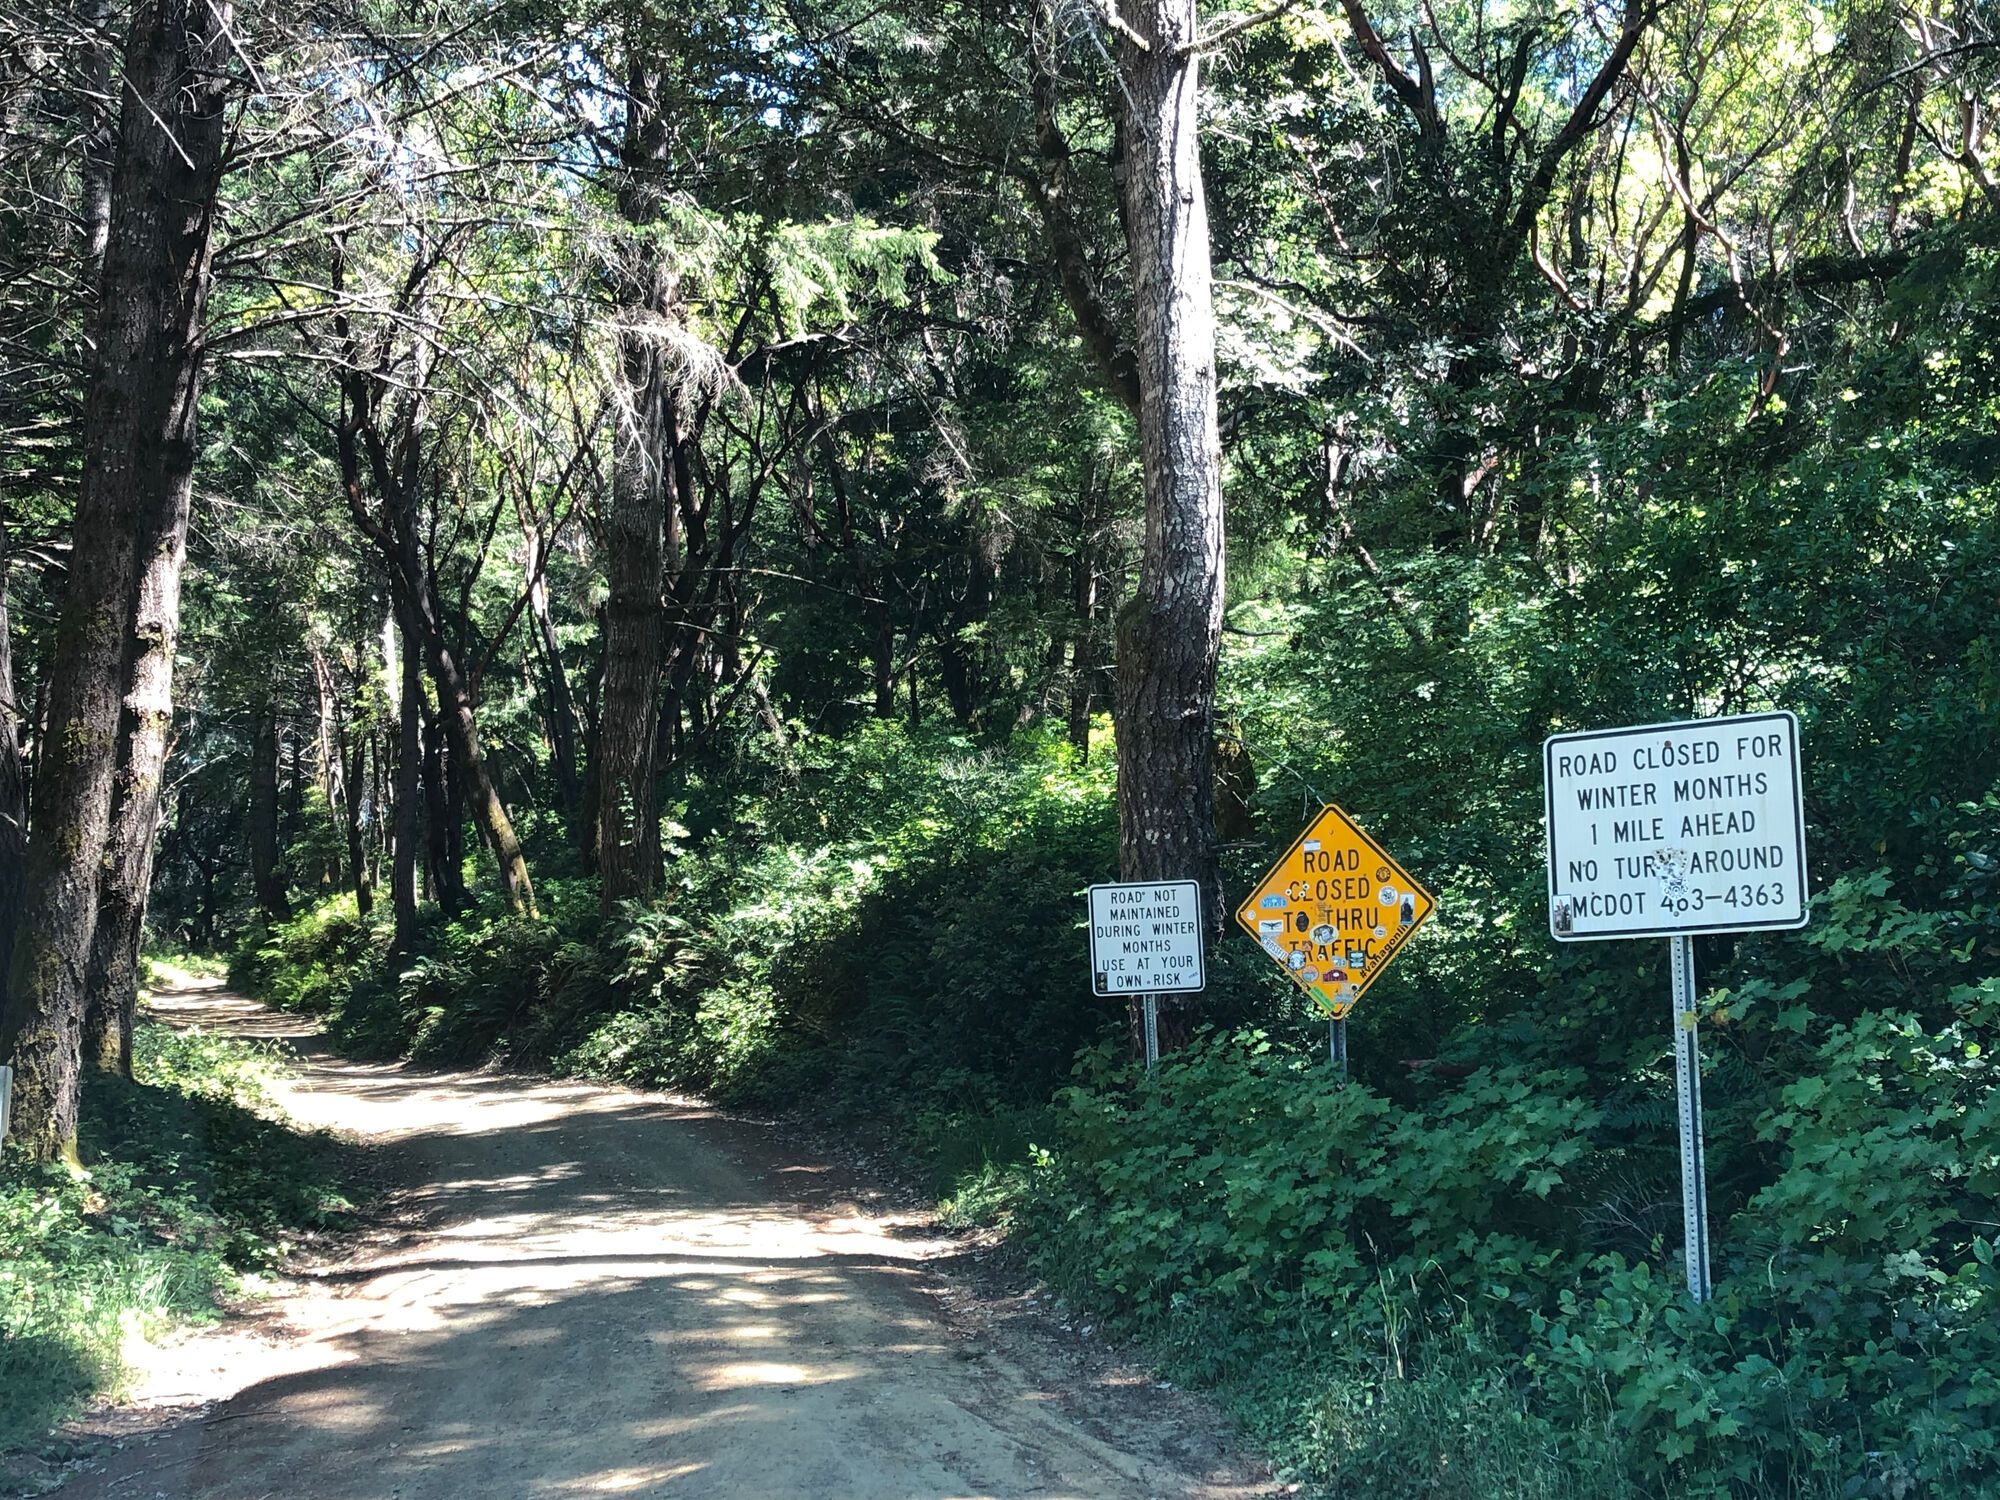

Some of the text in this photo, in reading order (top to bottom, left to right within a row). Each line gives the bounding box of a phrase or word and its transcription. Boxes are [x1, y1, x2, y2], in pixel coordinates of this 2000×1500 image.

[1559, 734, 1783, 778] ROAD CLOSED FOR
[1577, 772, 1768, 811] WINTER MONTHS
[1591, 810, 1756, 845] 1 MILE AHEAD
[1304, 849, 1360, 874] ROAD
[1569, 845, 1783, 883] NO TUR AROUND
[1111, 889, 1177, 904] ROAD NOT
[1289, 876, 1370, 902] CLOSED
[1110, 905, 1180, 921] MAINTAINED
[1573, 892, 1646, 918] MCDOT
[1097, 921, 1195, 938] DURING WINTER
[1283, 907, 1378, 933] T THRU
[1122, 939, 1171, 954] MONTHS
[1102, 955, 1194, 971] USE AT YOUR
[1116, 974, 1142, 988] OWN
[1153, 973, 1181, 986] RISK
